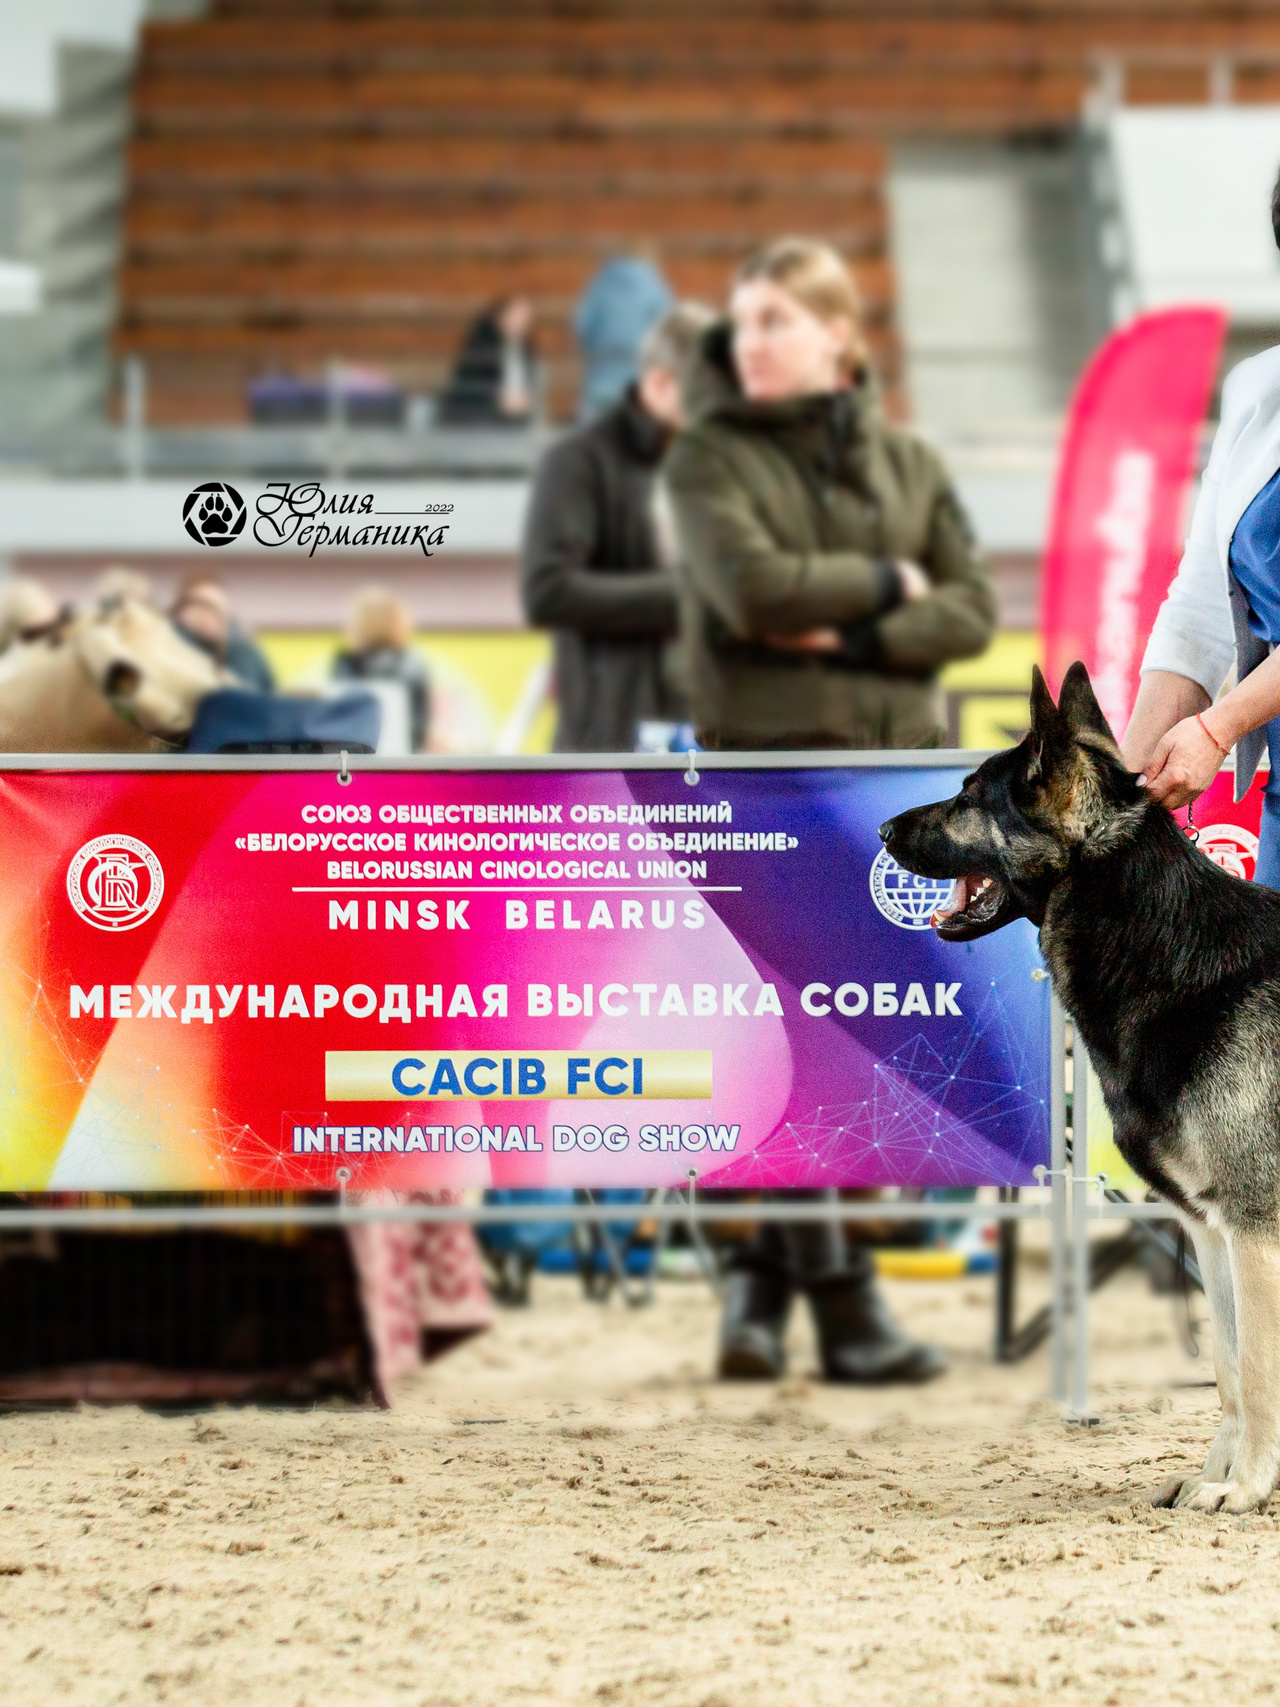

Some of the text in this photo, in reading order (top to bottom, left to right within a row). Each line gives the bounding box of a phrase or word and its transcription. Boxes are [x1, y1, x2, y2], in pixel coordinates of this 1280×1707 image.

[301, 800, 732, 826] СОЮЗ ОБЩЕСТВЕННЫХ ОБЪЕДИНЕНИЙ
[235, 831, 799, 854] «БЕЛОРУССКОЕ КИНОЛОГИЧЕСКОЕ ОБЪЕДИНЕНИЕ»
[327, 860, 707, 880] BELORUSSIAN CINOLOGICAL UNION
[898, 873, 938, 888] FCI
[329, 899, 706, 931] MINSK BELARUS
[69, 982, 963, 1024] МЕЖДУНАРОДНАЯ ВЫСТАВКА СОБАК
[391, 1057, 643, 1096] CACIB FCI
[292, 1123, 741, 1154] INTERNATIONAL DOG SHOW
